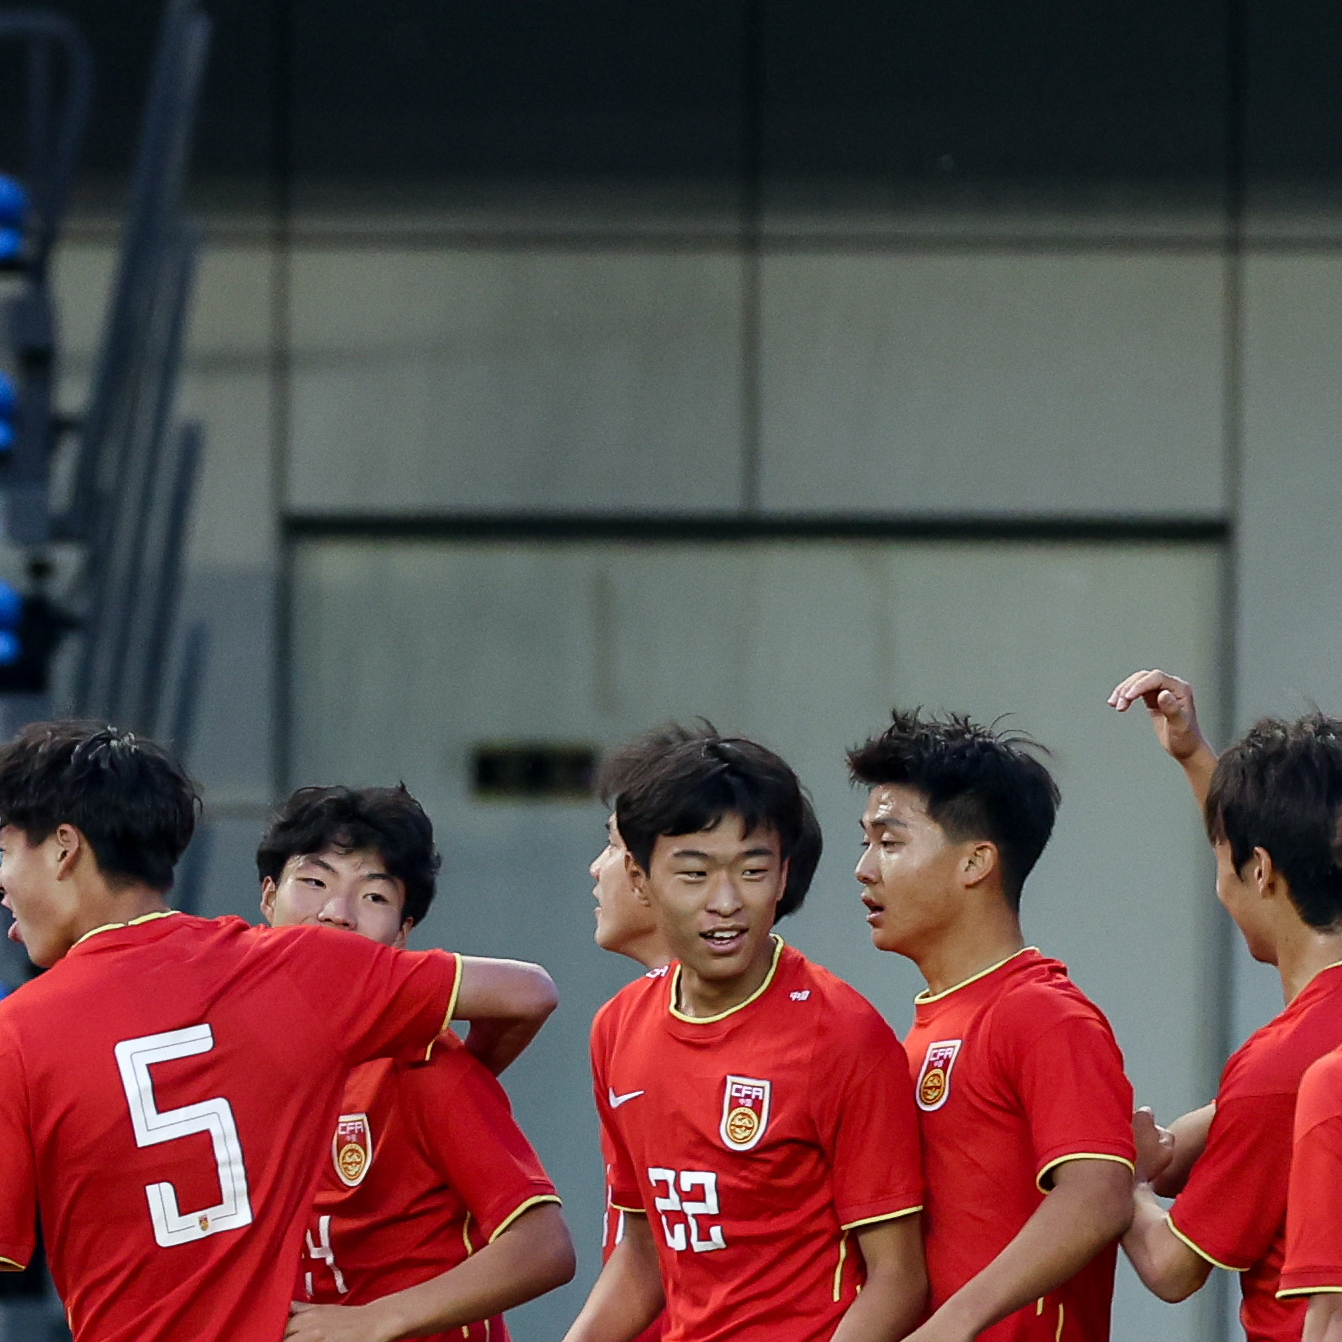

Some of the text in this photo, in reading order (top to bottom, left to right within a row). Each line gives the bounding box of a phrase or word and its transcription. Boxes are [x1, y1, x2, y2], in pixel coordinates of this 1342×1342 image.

[731, 1084, 764, 1100] CFA
[114, 1023, 254, 1248] 5
[648, 1167, 726, 1253] 22
[302, 1215, 348, 1297] 4
